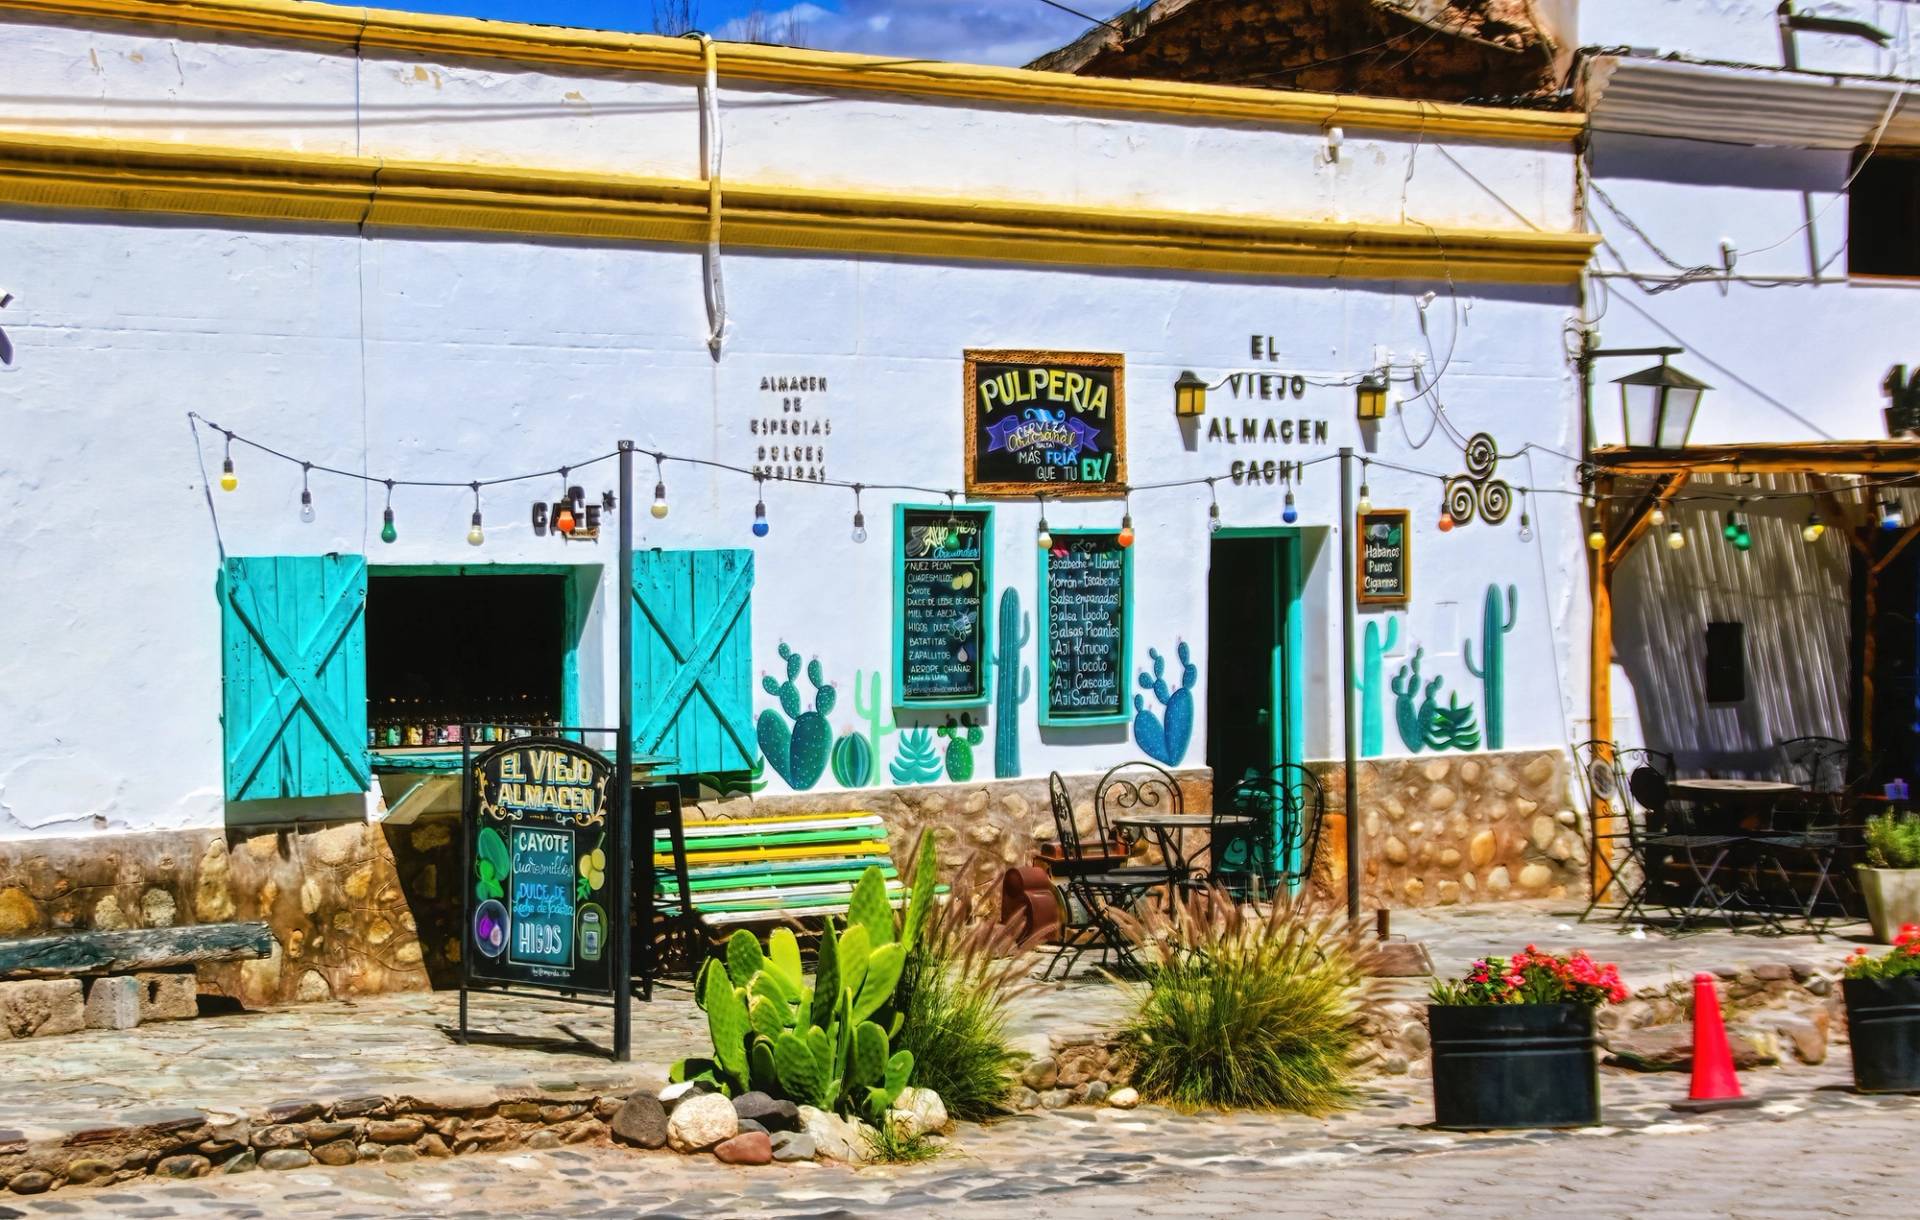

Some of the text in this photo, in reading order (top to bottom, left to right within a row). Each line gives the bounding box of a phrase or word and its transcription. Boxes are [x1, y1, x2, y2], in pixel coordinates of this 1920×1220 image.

[1251, 335, 1280, 362] EL
[760, 376, 827, 392] ALMACEN
[1230, 374, 1305, 400] VIEJO
[980, 368, 1109, 420] PULPERIA
[783, 397, 801, 413] DE
[750, 418, 831, 435] ESPECIAS
[1016, 421, 1068, 439] CERVEZA
[1208, 416, 1329, 444] ALMACEN
[758, 446, 824, 462] DULCES
[1018, 446, 1041, 465] MÁS
[1036, 453, 1112, 482] QUE TU EX!
[1231, 459, 1304, 486] CACHI
[1365, 543, 1400, 559] Habanos
[910, 562, 929, 571] NUEZ
[1095, 553, 1121, 569] Llama
[1369, 560, 1393, 573] Puros
[1083, 570, 1121, 587] Escabeche
[1364, 576, 1398, 593] Cigarros
[928, 598, 935, 606] DE
[956, 598, 963, 606] DE
[1050, 587, 1075, 605] Salsa
[908, 610, 922, 618] MIEL
[926, 610, 934, 618] DE
[1050, 603, 1110, 621] Salsa Locoto
[908, 623, 928, 633] HIGOS
[1050, 621, 1083, 640] Salsas
[909, 638, 947, 647] BATATITAS
[909, 651, 951, 661] ZAPALLITOS
[1077, 655, 1108, 672] Locoto
[911, 664, 939, 674] ARROPE
[1075, 671, 1115, 690] Cascabel
[1071, 688, 1100, 706] Santa
[500, 750, 594, 786] EL VIEJO
[498, 784, 595, 814] ALMACEN
[518, 832, 569, 854] CAYOTE
[519, 882, 566, 900] DULCE DE
[519, 922, 563, 955] HIGOS
